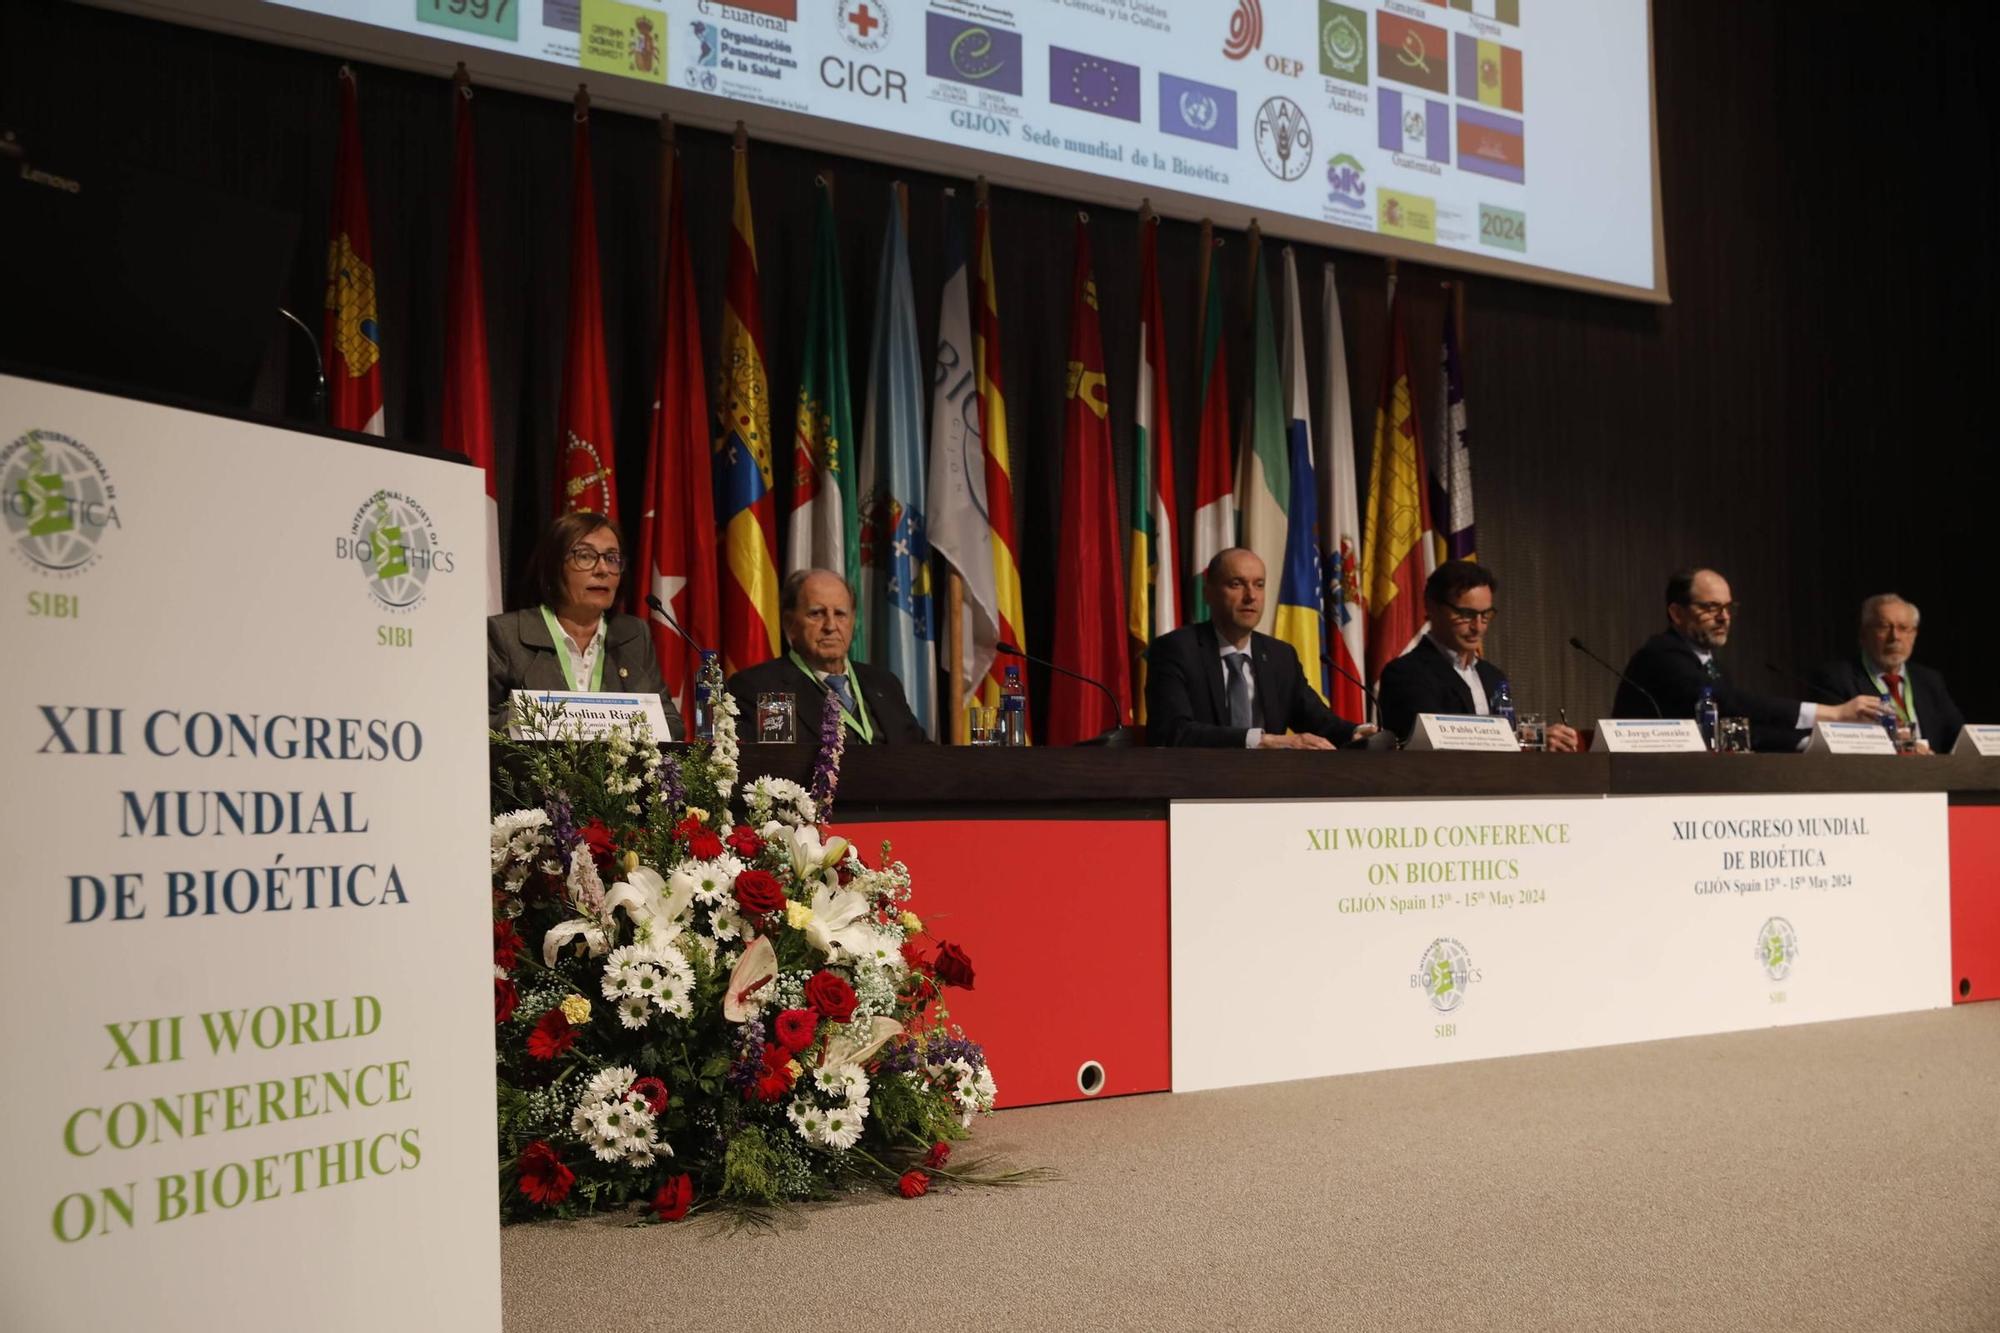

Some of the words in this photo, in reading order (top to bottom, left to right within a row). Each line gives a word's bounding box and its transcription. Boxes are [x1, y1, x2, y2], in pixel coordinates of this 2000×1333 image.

[1109, 8, 1116, 20] y
[1118, 9, 1128, 21] la
[1130, 12, 1171, 32] Cultura
[721, 27, 792, 53] Organización
[721, 42, 798, 69] Panamericana
[721, 56, 734, 70] de
[738, 59, 748, 72] la
[751, 63, 782, 80] Salud
[1264, 54, 1304, 79] OEP
[820, 55, 908, 104] CICR
[1022, 125, 1060, 149] Sede
[1064, 137, 1123, 162] mundial
[1131, 149, 1149, 168] de
[1153, 152, 1166, 171] la
[1171, 156, 1230, 185] Bioética
[1391, 153, 1442, 177] Guatemala
[1481, 212, 1525, 242] 2024
[405, 496, 433, 529] SOCIETY
[27, 590, 80, 619] SIBI
[376, 625, 414, 648] SIBI
[563, 708, 606, 720] Isolina
[36, 705, 127, 755] XII
[144, 709, 424, 762] CONGRESO
[119, 790, 370, 838] MUNDIAL
[1306, 828, 1339, 851] XII
[1345, 826, 1428, 849] WORLD
[1433, 823, 1571, 847] CONFERENCE
[1672, 820, 1697, 841] XII
[1702, 819, 1793, 840] CONGRESO
[1797, 817, 1870, 838] MUNDIAL
[1723, 851, 1745, 870] DE
[1750, 845, 1827, 869] BIOÉTICA
[1368, 863, 1399, 886] ON
[1406, 859, 1519, 884] BIOETHICS
[1734, 878, 1761, 896] Spain
[1831, 873, 1853, 888] 2024
[65, 873, 146, 924] DE
[164, 853, 410, 918] BIOÉTICA
[1338, 892, 1386, 914] GIJÓN
[1389, 895, 1426, 915] Spain
[1489, 890, 1515, 908] May
[1519, 889, 1547, 904] 2024
[103, 1016, 185, 1071] XII
[199, 994, 382, 1056] WORLD
[1434, 1023, 1456, 1038] SIBI
[63, 1060, 413, 1158] CONFERENCE
[51, 1182, 138, 1244] ON
[154, 1128, 422, 1224] BIOETHICS
